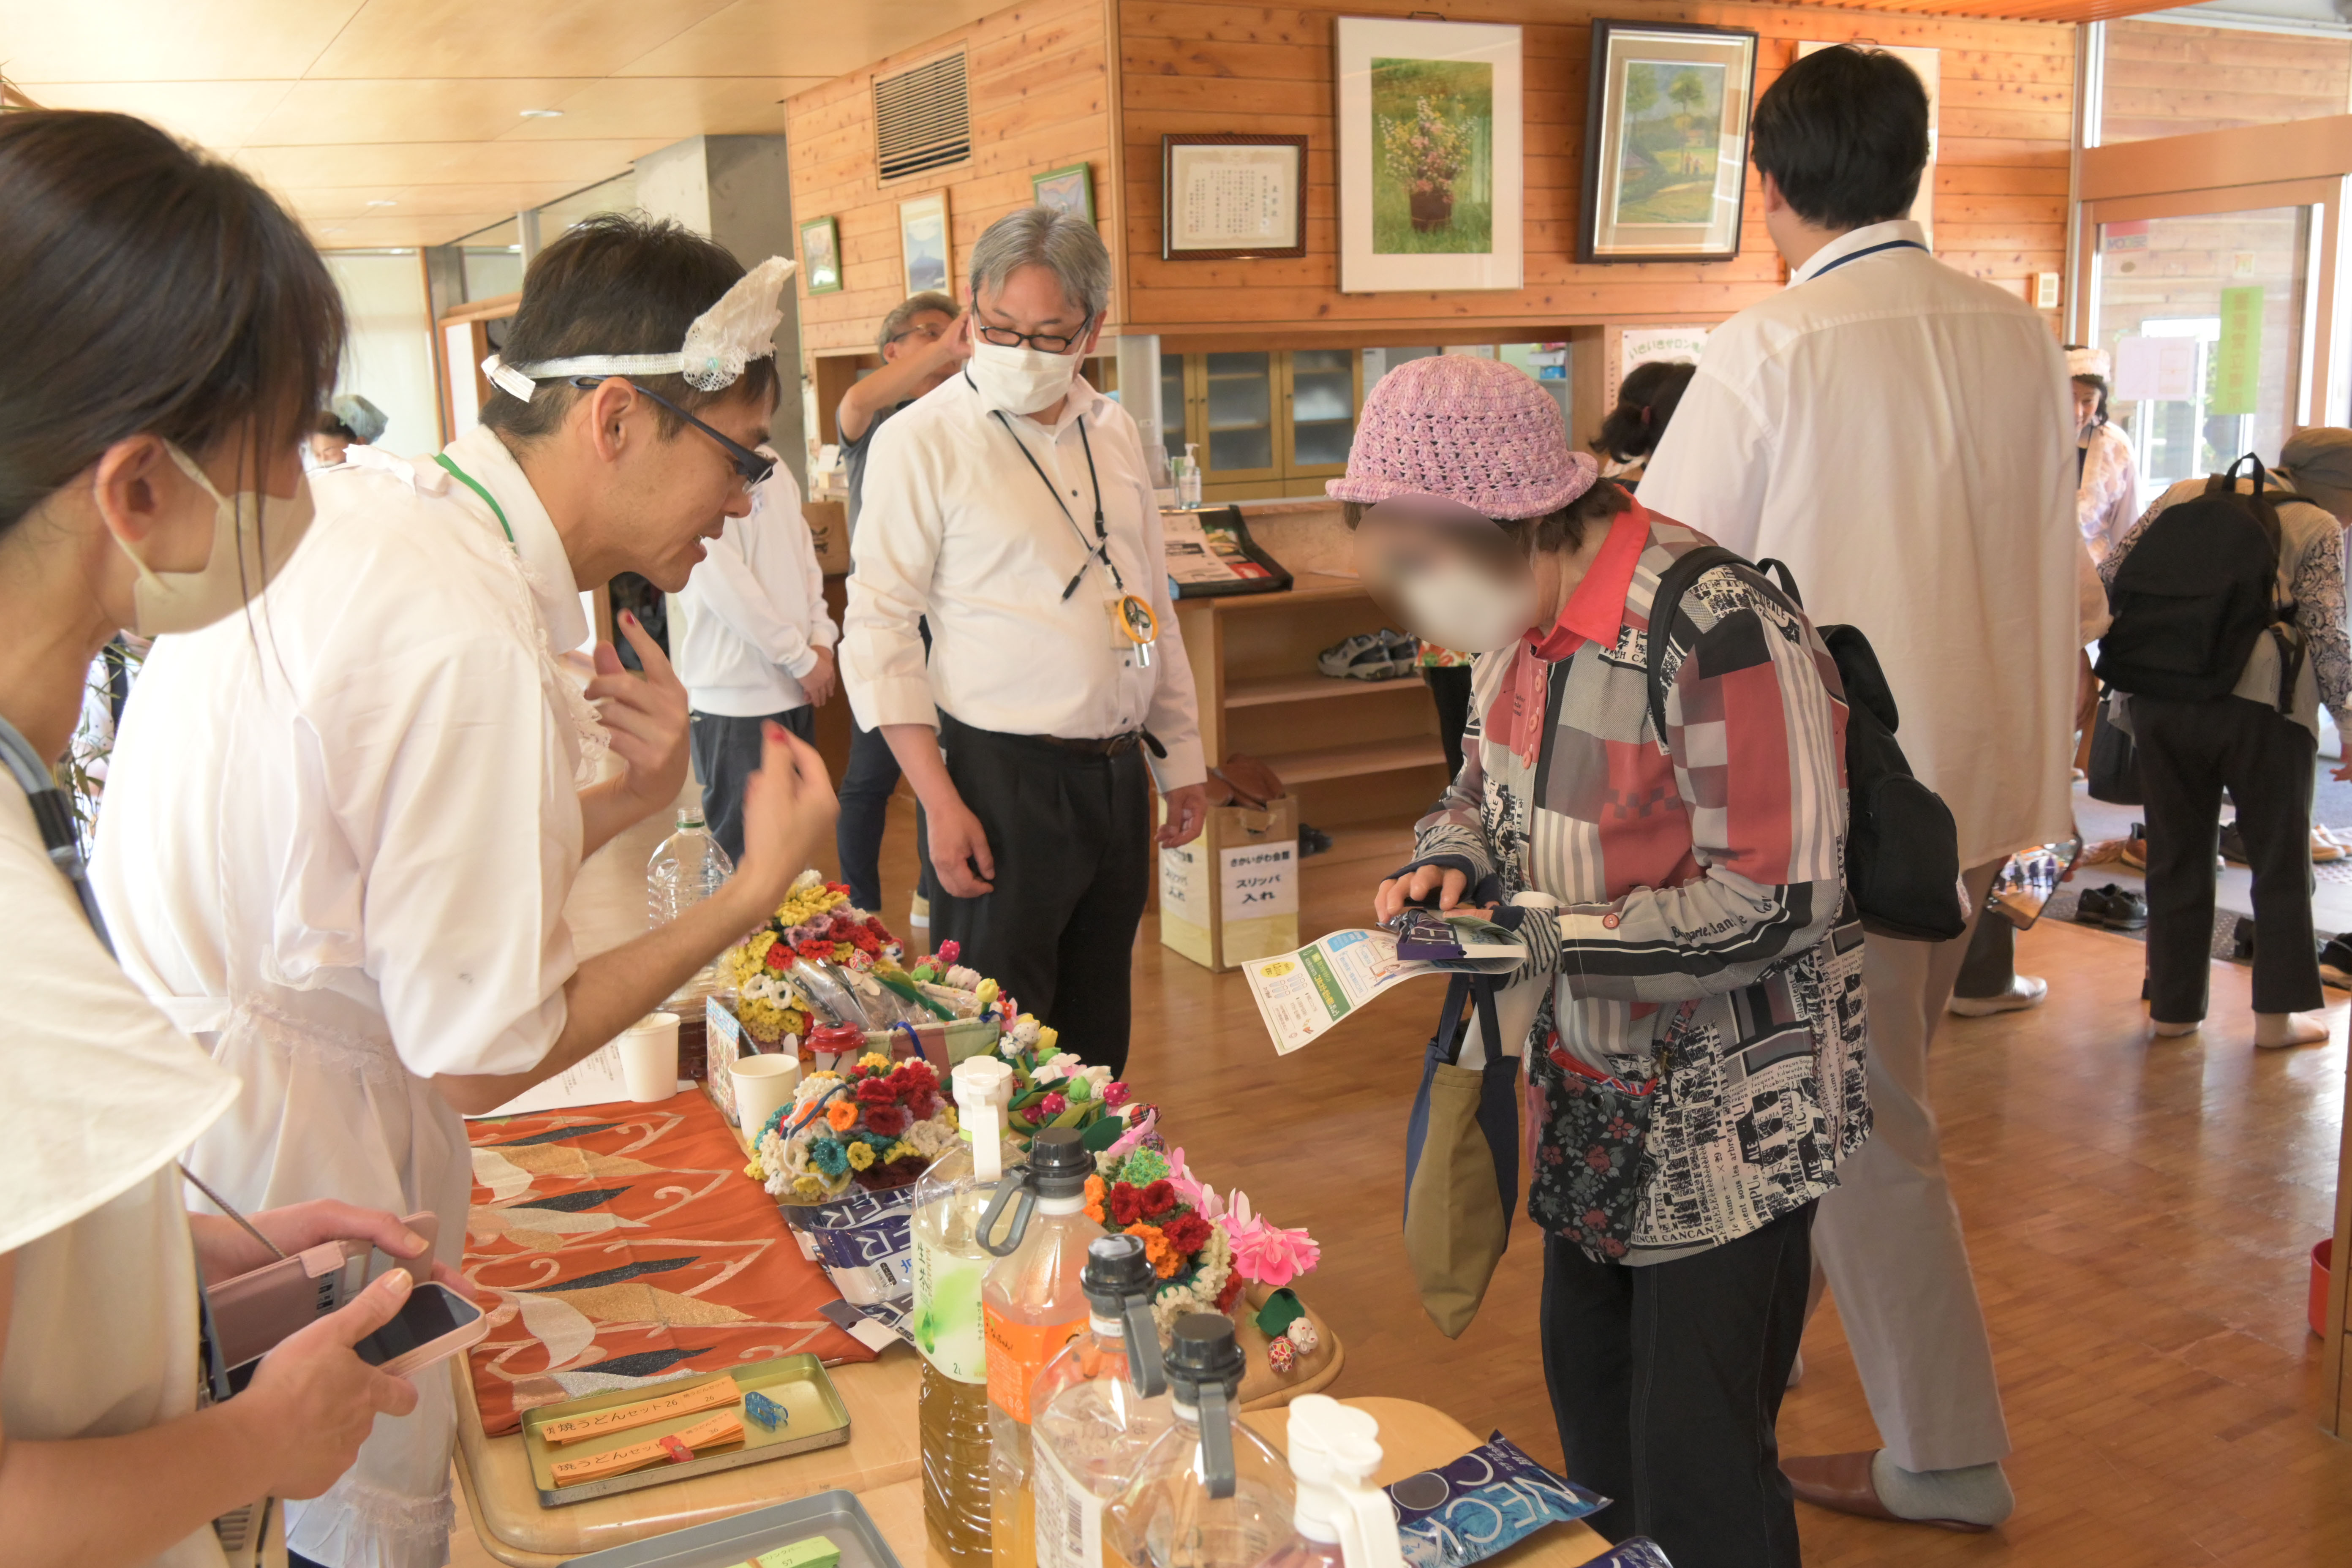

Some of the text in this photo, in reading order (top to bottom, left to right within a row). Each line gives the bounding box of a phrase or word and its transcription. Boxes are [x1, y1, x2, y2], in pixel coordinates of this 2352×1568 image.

[1230, 851, 1290, 868] さかいがわ会館
[1236, 874, 1281, 889] スリッパ
[1242, 891, 1276, 904] 入れ
[1789, 980, 1805, 1018] chantent
[1752, 1111, 1780, 1126] PICABIA
[1737, 1180, 1745, 1200] sous
[1725, 1194, 1735, 1222] t'aime
[1662, 1225, 1714, 1241] CANCAN
[953, 1362, 962, 1376] 2L
[683, 1381, 727, 1398] 焼うどんセット
[558, 1404, 663, 1432] 焼うどんセット
[666, 1399, 678, 1407] 26
[557, 1443, 661, 1472] 焼うどんセット
[1400, 1468, 1580, 1563] NECK
[782, 1558, 793, 1567] 57
